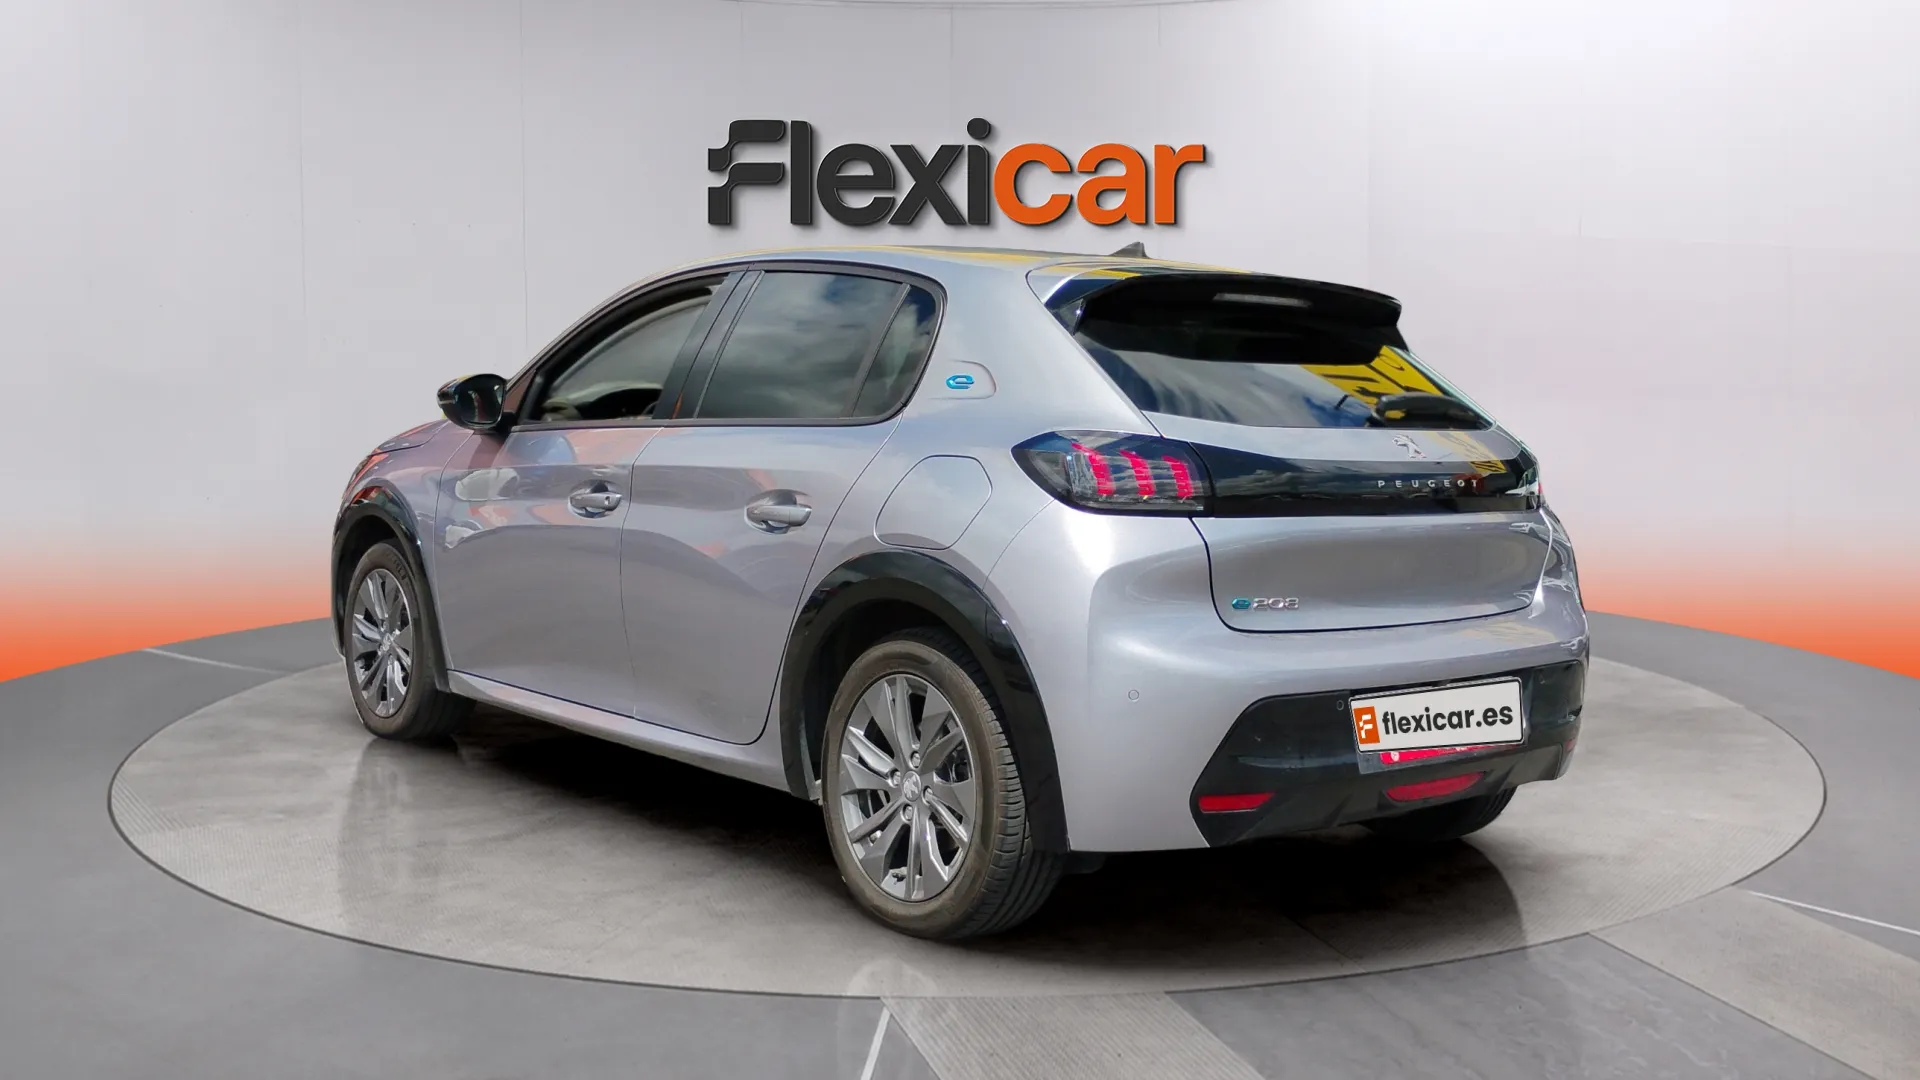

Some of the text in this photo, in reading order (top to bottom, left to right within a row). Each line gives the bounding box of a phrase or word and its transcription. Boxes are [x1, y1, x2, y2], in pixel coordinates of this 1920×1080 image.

[707, 117, 1206, 226] Flexicar
[1377, 479, 1479, 489] PEUGEOT
[1381, 705, 1514, 736] flexicar.es
